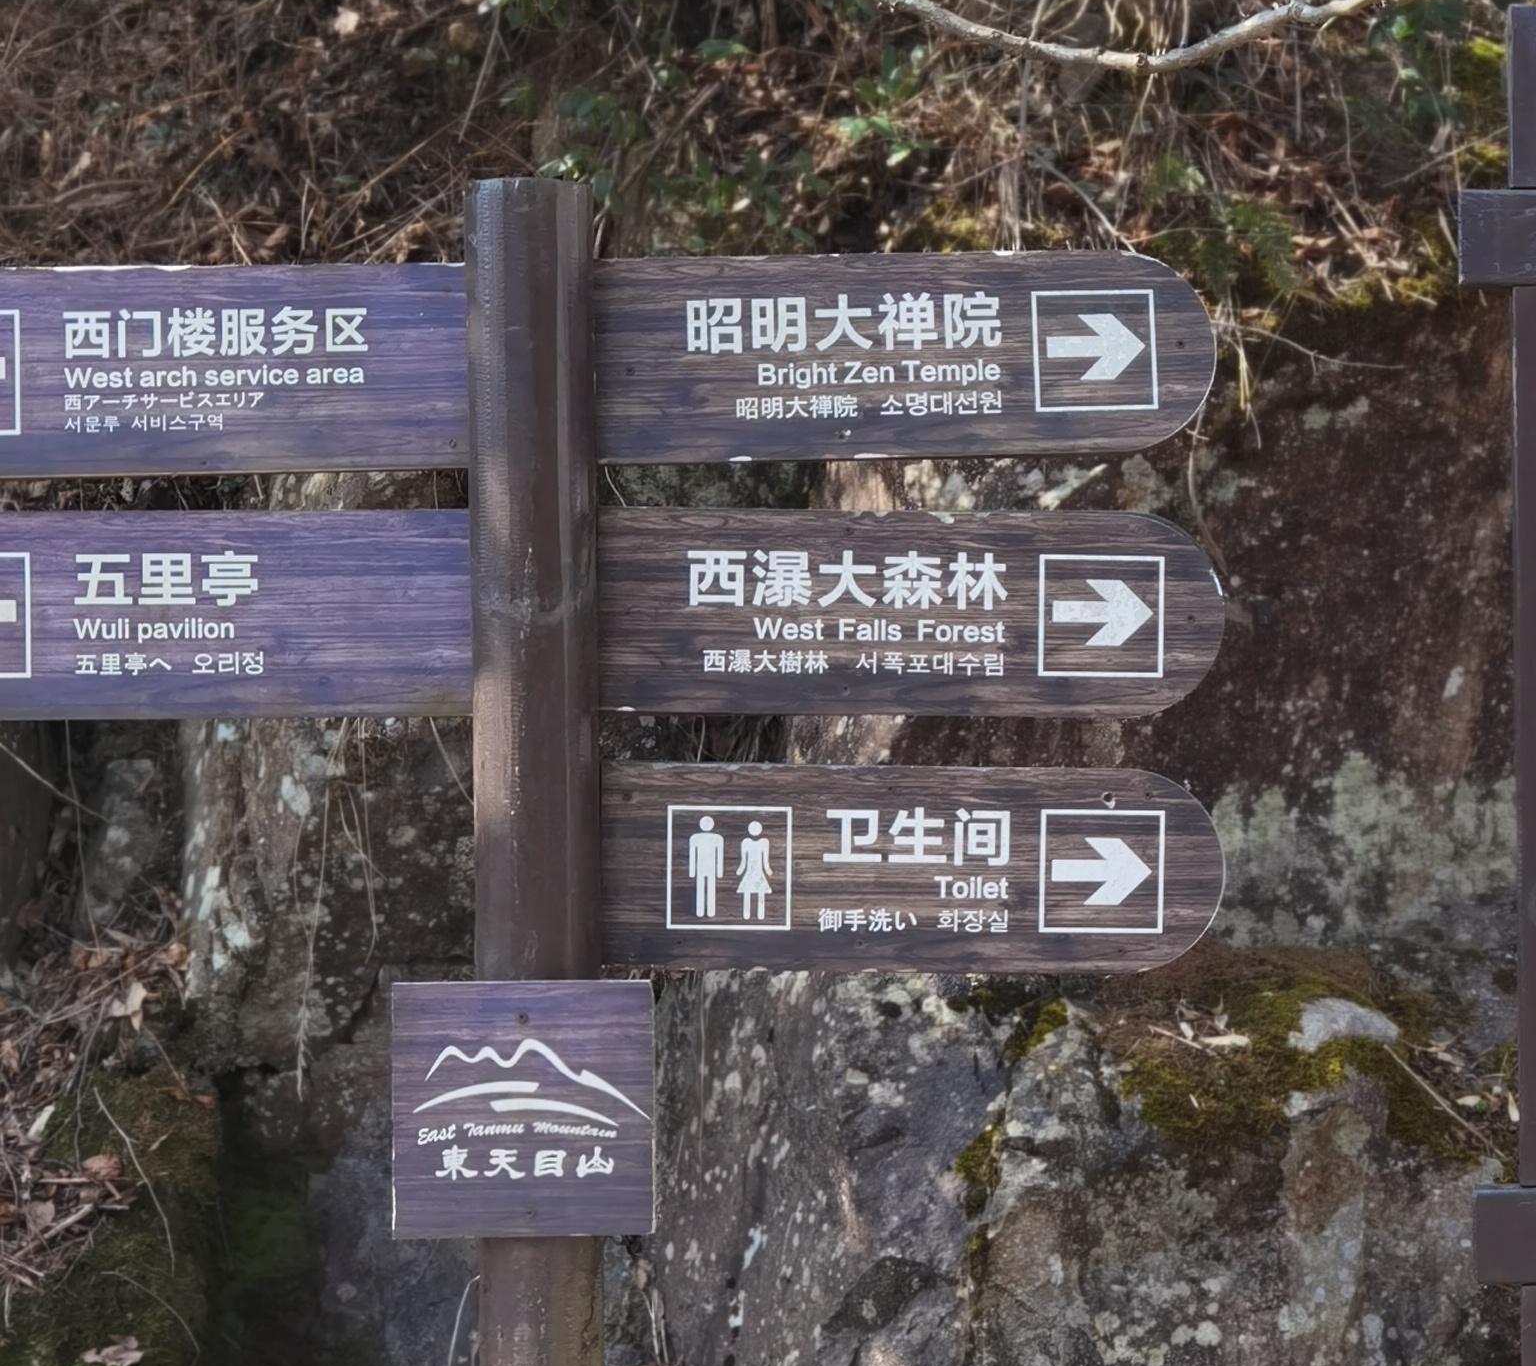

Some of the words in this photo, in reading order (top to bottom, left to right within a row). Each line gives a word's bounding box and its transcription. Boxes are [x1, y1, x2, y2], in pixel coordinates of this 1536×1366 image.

[63, 306, 369, 359] 西门楼服务区
[686, 292, 1003, 355] 昭明大禅院
[64, 367, 134, 389] West
[140, 366, 198, 388] arch
[205, 366, 299, 388] service
[306, 366, 364, 385] area
[758, 363, 837, 388] Bright
[844, 362, 895, 384] Zen
[901, 360, 1001, 386] Temple
[64, 391, 264, 411] 西アーチサービスエリア
[880, 391, 1003, 417] 소명대선원
[65, 414, 120, 433] 서문루
[131, 413, 223, 432] 서비스구역
[74, 551, 259, 607] 五里亭
[687, 550, 1008, 610] 西瀑大森林
[74, 618, 130, 640] Wuli
[137, 618, 234, 643] pavilion
[754, 618, 824, 641] West
[839, 618, 902, 642] Falls
[917, 619, 1005, 643] Forest
[75, 653, 172, 676] 五里亭へ
[193, 651, 264, 675] 오리정
[702, 651, 828, 675] 西瀑大樹林
[856, 652, 1005, 677] 서폭포대수림
[823, 809, 1010, 866] 卫生间
[934, 876, 1008, 899] Toilet
[818, 908, 917, 933] 御手洗い
[937, 909, 1009, 933] 화장실
[417, 1124, 456, 1145] East
[435, 1145, 614, 1181] 東天目山
